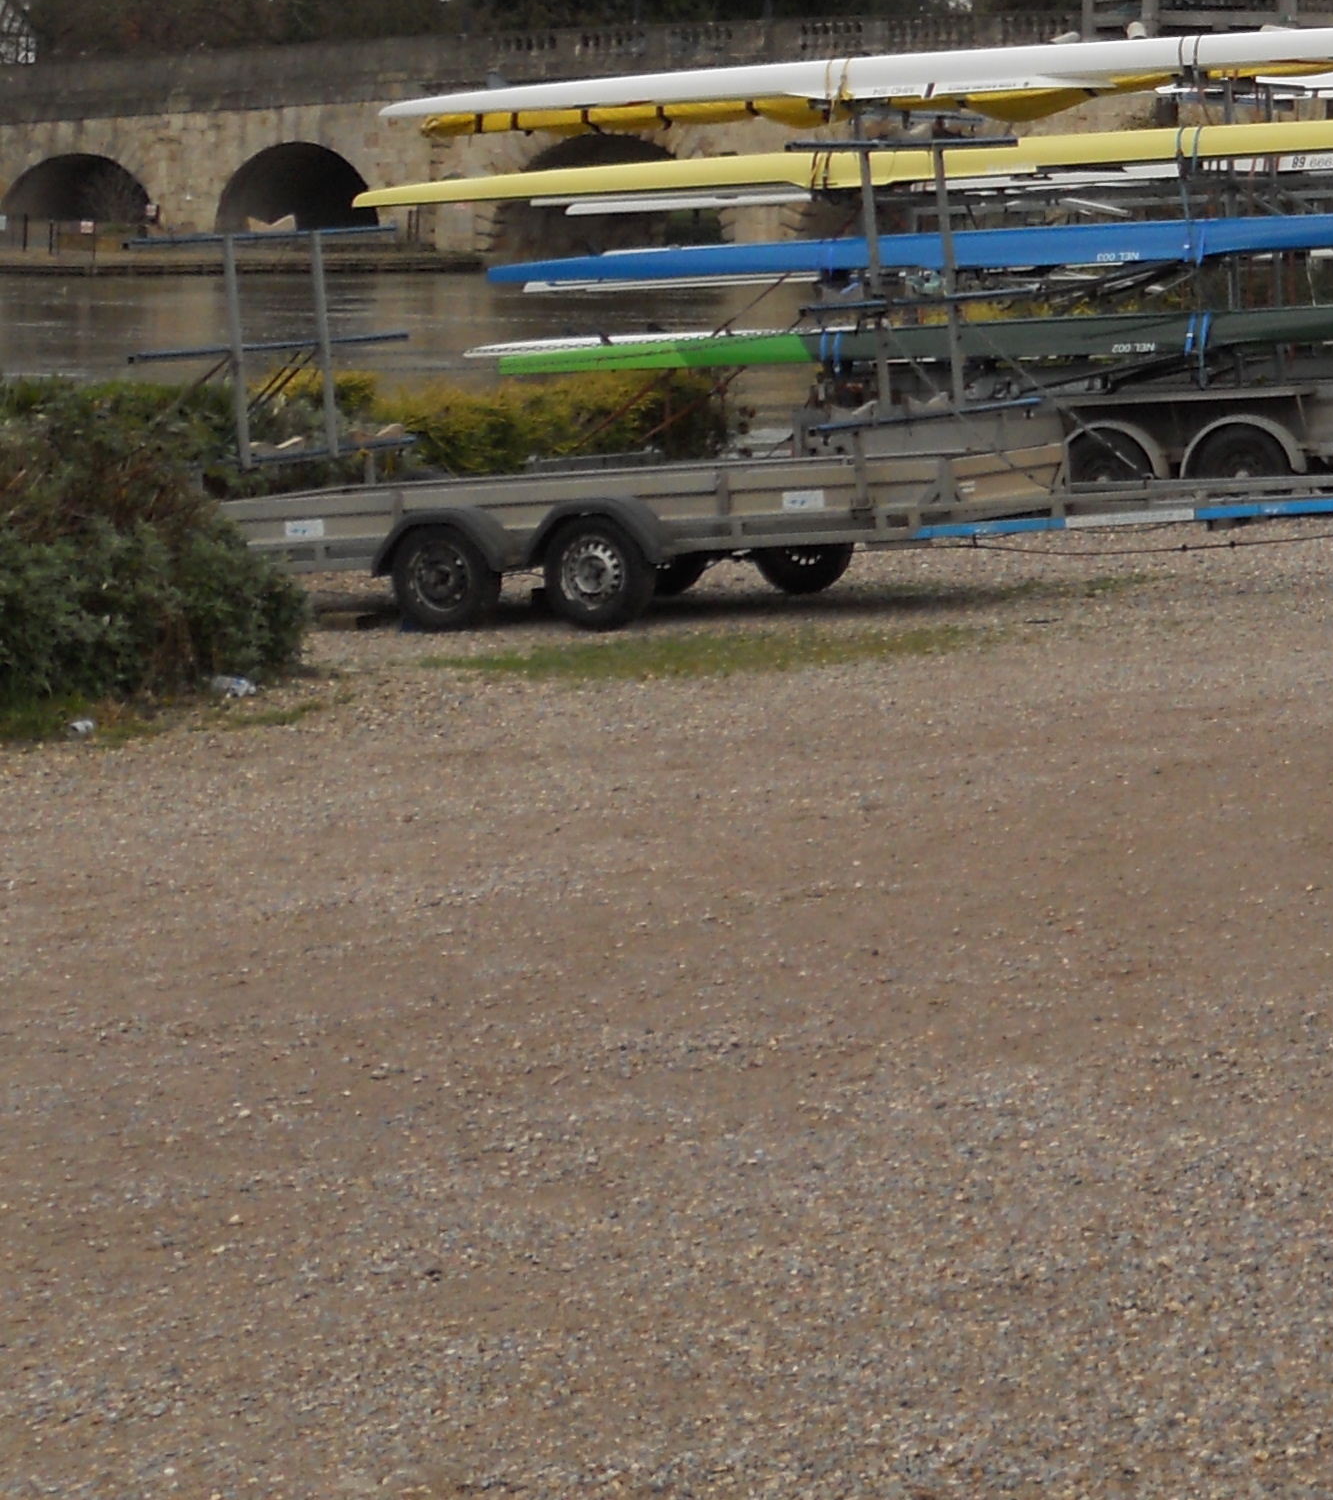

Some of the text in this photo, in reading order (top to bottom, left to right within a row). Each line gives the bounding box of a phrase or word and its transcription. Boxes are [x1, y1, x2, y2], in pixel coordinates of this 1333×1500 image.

[1096, 252, 1140, 262] NEL 003
[1111, 343, 1155, 353] NEL 002
